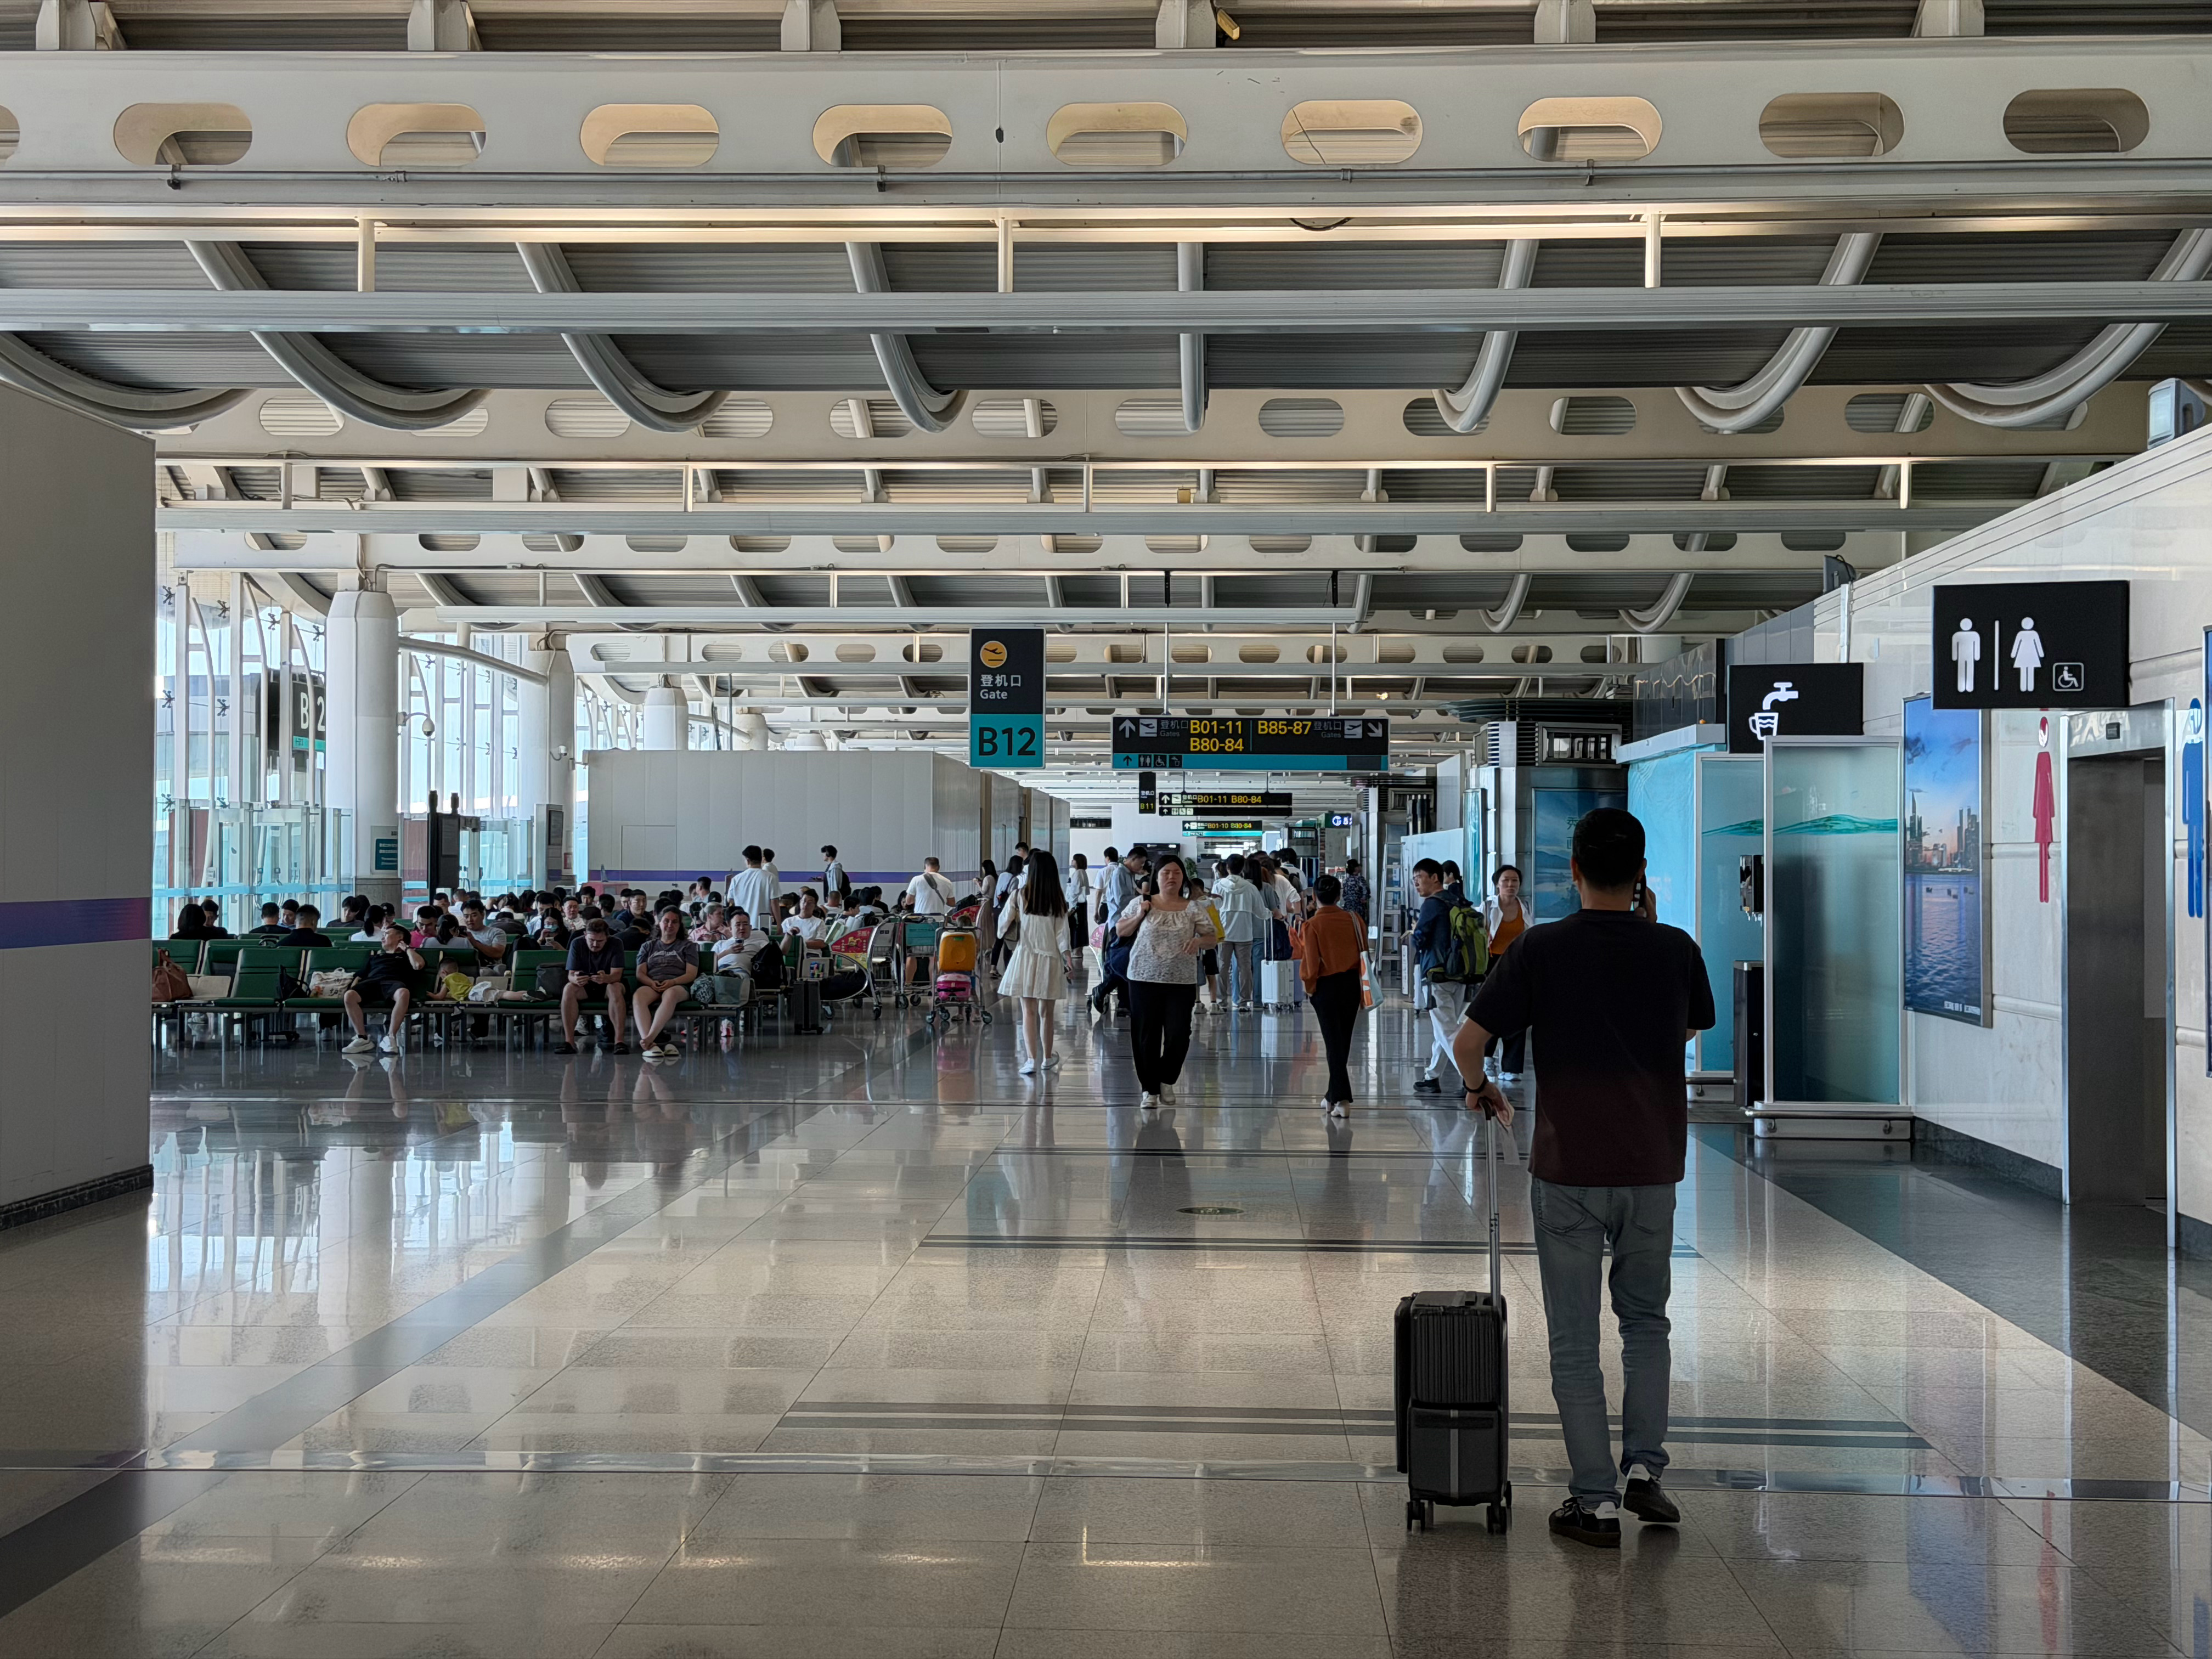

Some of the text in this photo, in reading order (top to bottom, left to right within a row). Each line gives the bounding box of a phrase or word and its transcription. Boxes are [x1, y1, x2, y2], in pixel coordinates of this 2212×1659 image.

[980, 674, 1022, 687] 登机口
[980, 689, 1008, 699] Gate
[1160, 720, 1189, 730] 登机口
[1190, 720, 1242, 734] B01-11
[1258, 720, 1312, 735] B85-87
[1313, 721, 1342, 731] 登机口
[979, 727, 1036, 756] B12
[1190, 738, 1244, 752] B80-84
[1198, 795, 1262, 804] B01-11 B80-84
